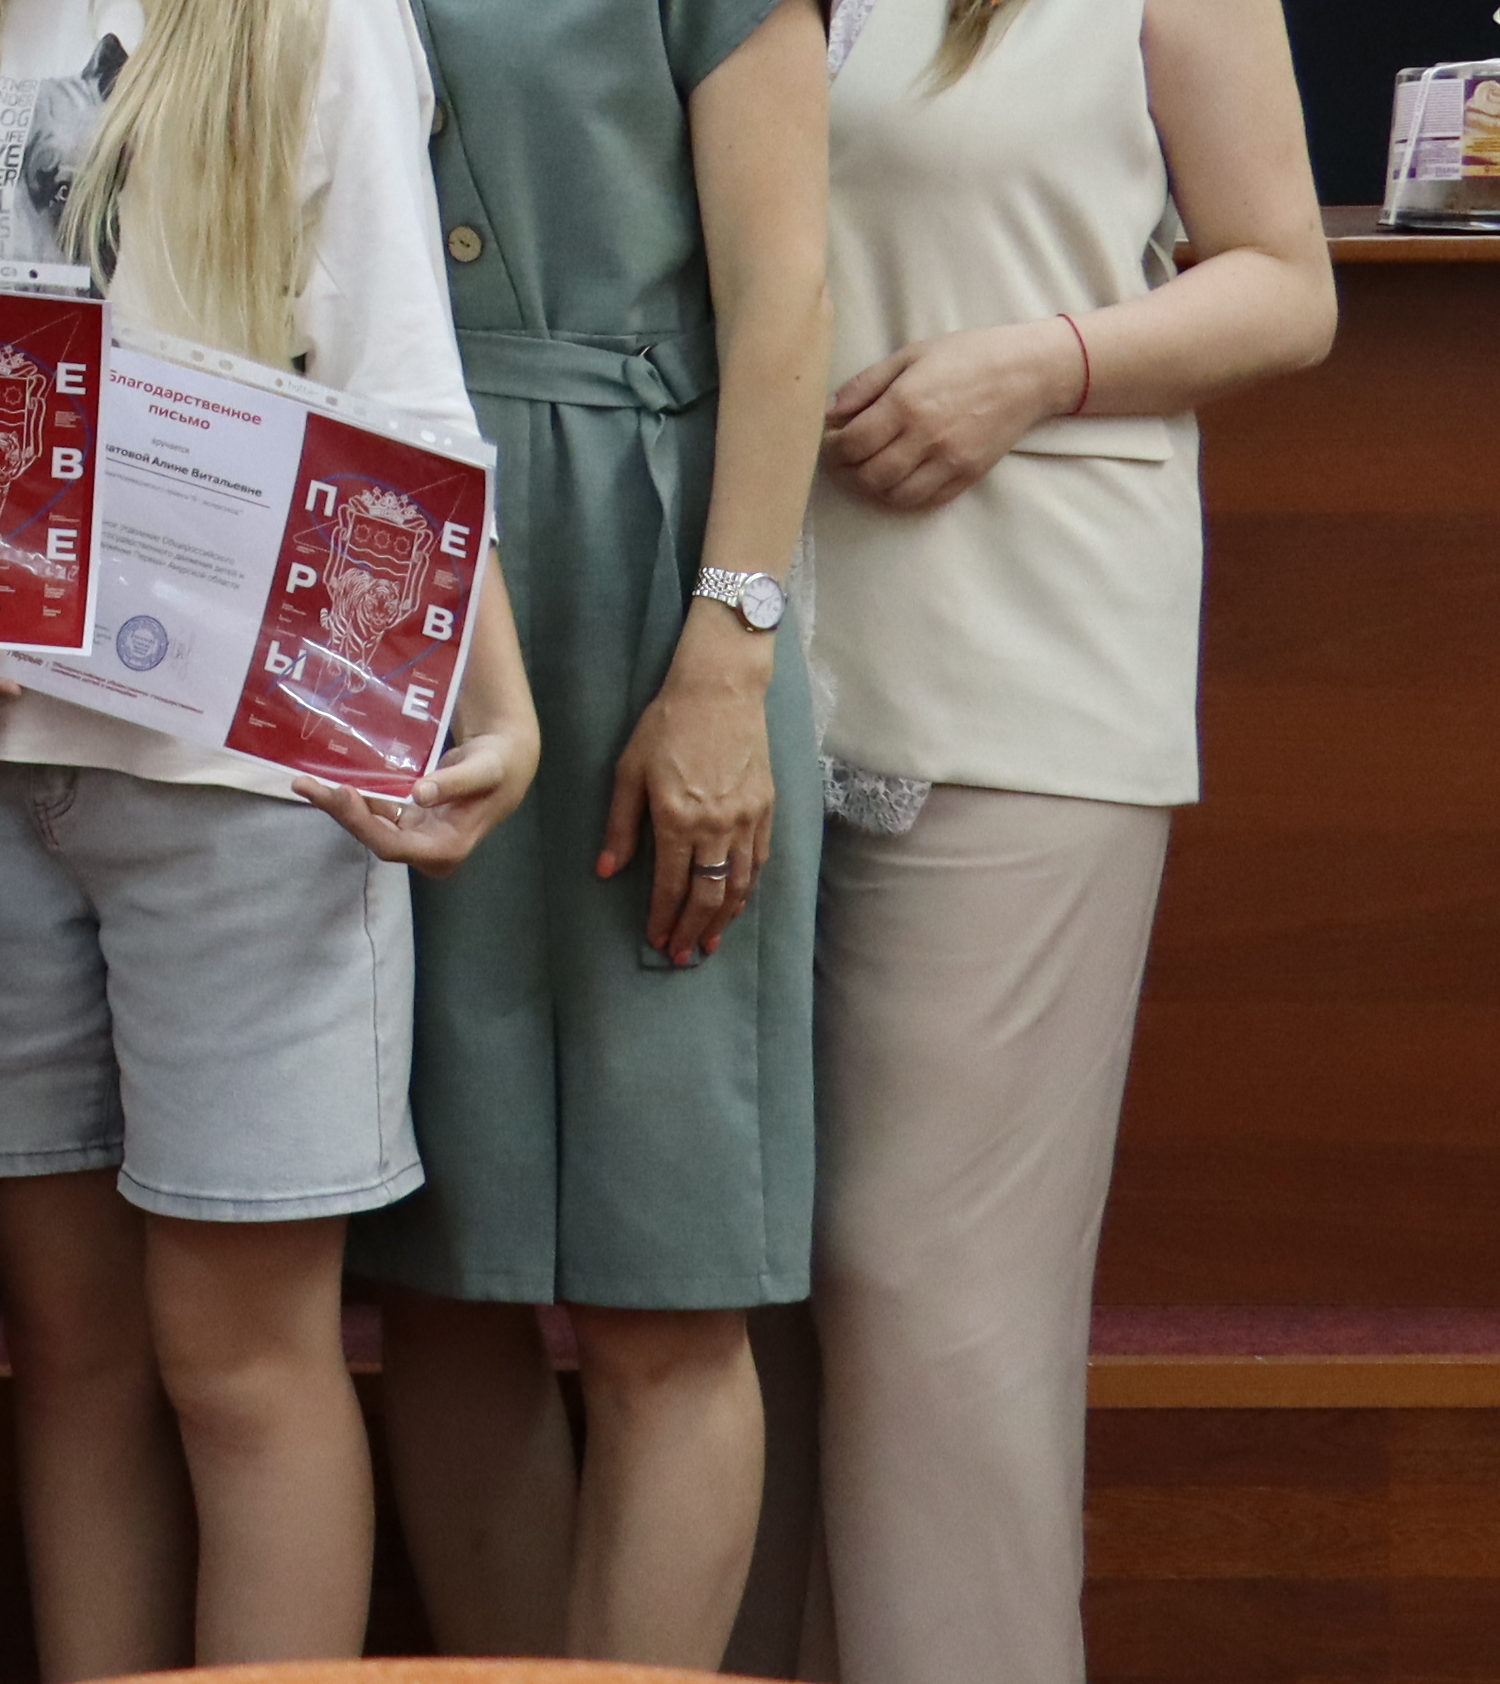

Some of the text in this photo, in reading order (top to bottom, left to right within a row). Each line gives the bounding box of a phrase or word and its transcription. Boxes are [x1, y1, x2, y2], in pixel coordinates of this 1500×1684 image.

[56, 361, 87, 396] Е
[146, 401, 213, 432] письмо
[51, 446, 86, 480] В
[150, 455, 189, 476] Алине
[190, 467, 263, 498] Витальевне
[305, 480, 471, 559] П Е
[46, 527, 77, 562] Е
[285, 562, 454, 641] Р В
[264, 641, 434, 722] Ы Е
